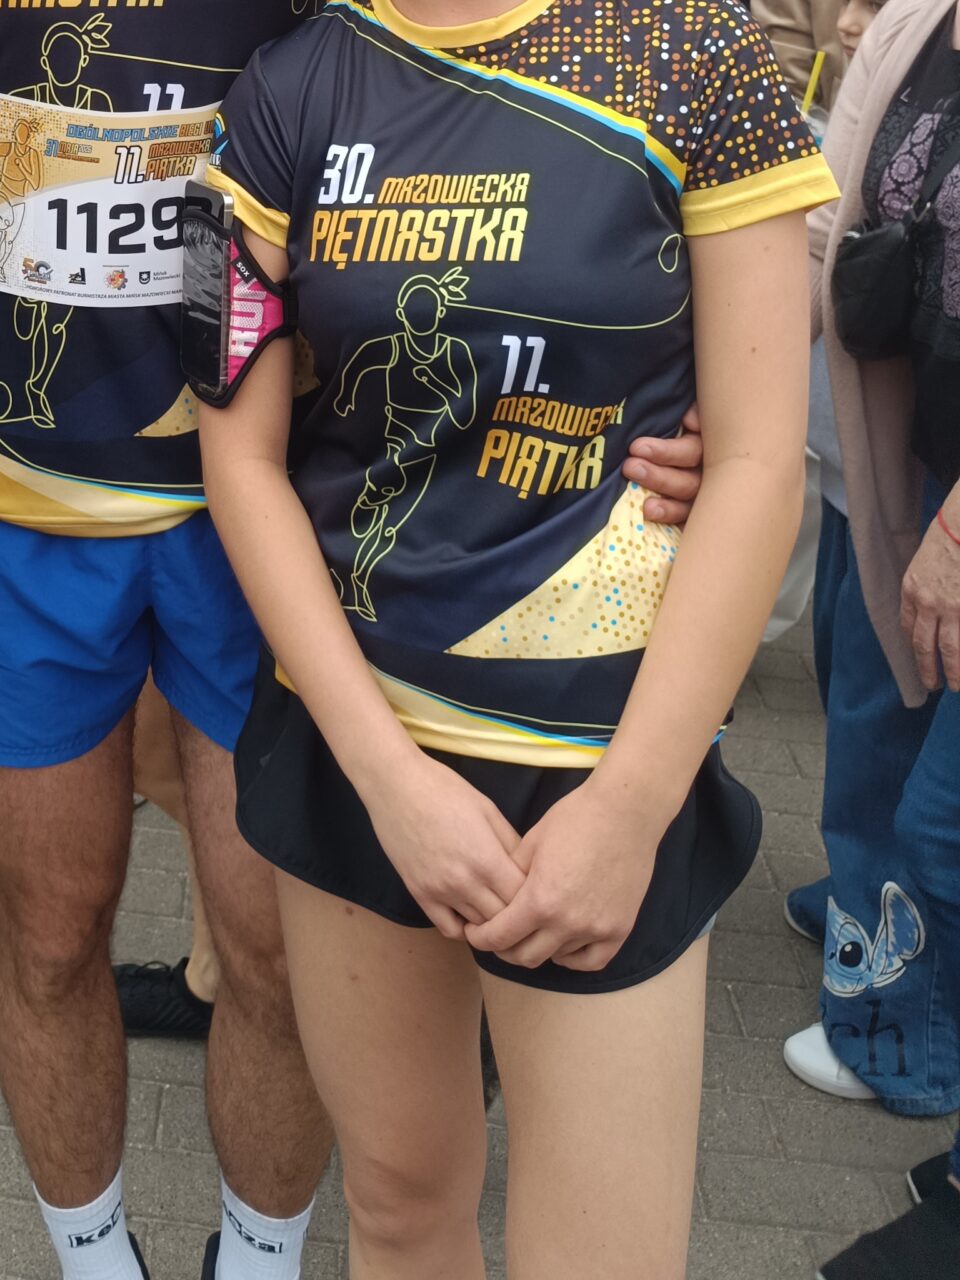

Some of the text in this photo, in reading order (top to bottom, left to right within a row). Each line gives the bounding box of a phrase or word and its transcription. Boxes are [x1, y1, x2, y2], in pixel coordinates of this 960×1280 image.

[114, 137, 212, 184] 11. MAZOWIECKA
[144, 155, 197, 182] PIĄTKA
[318, 143, 530, 205] 30. MAZOWIECKA
[47, 196, 186, 254] 1129
[309, 208, 529, 270] PIĘTNASTKA
[500, 335, 550, 394] 11.
